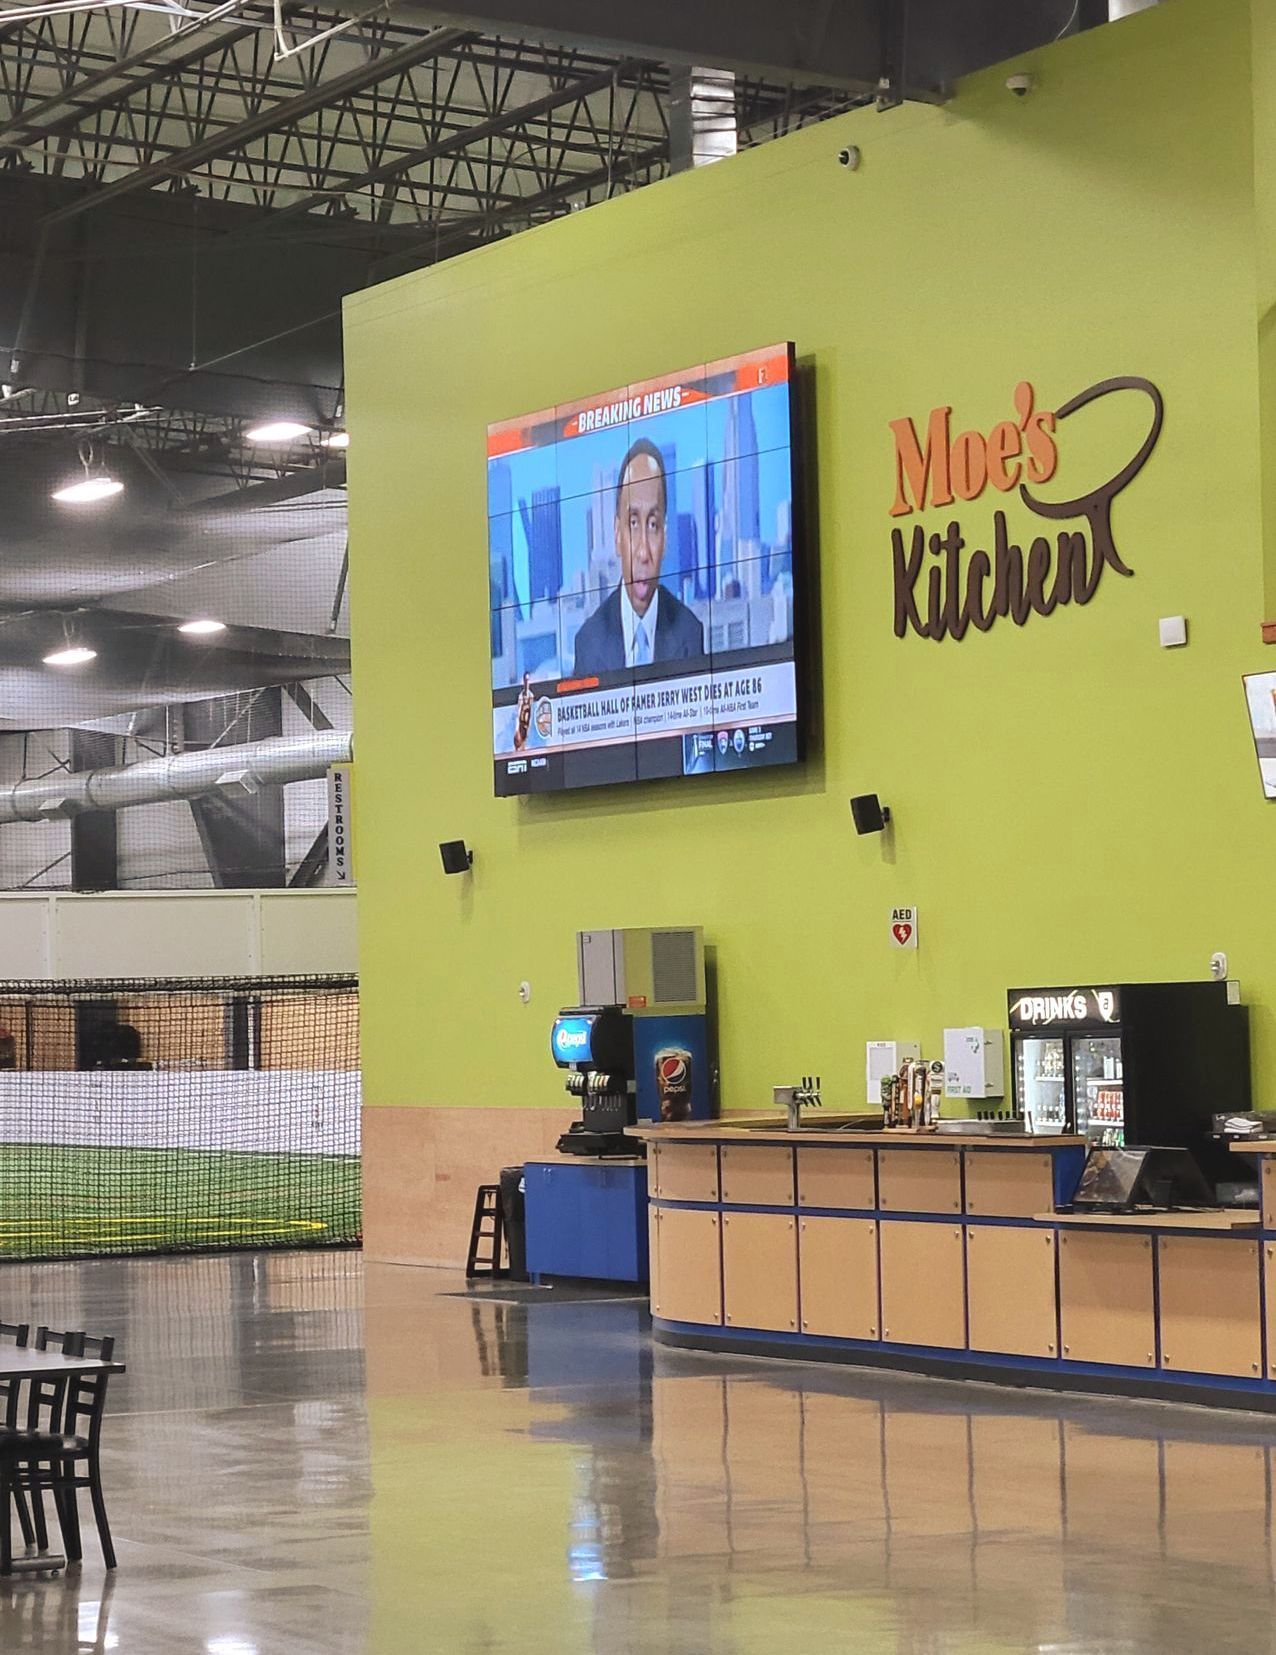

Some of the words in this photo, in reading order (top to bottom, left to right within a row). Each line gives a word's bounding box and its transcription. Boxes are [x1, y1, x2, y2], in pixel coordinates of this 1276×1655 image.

[578, 397, 642, 433] BREAKING
[643, 386, 682, 415] NEWS
[889, 380, 1058, 517] Moe's
[891, 510, 1106, 642] Kitchen
[557, 701, 600, 722] BASKETBALL
[600, 698, 619, 716] HALL
[620, 696, 630, 713] OF
[631, 693, 656, 711] FAMER
[657, 689, 680, 708] JERRY
[681, 686, 703, 704] WEST
[704, 682, 722, 700] DIES
[723, 681, 734, 698] AT
[735, 679, 751, 697] AGE
[752, 676, 762, 694] 86
[737, 701, 747, 711] First
[747, 700, 759, 709] Team
[616, 719, 630, 728] Lakers
[643, 714, 664, 725] champion
[507, 759, 527, 775] ESPN
[334, 772, 345, 867] RESTROOMS
[892, 908, 912, 920] AED
[1019, 995, 1087, 1021] DRINKS
[663, 1084, 687, 1094] pepsi
[947, 1085, 961, 1094] FIRST
[962, 1085, 972, 1094] AID
